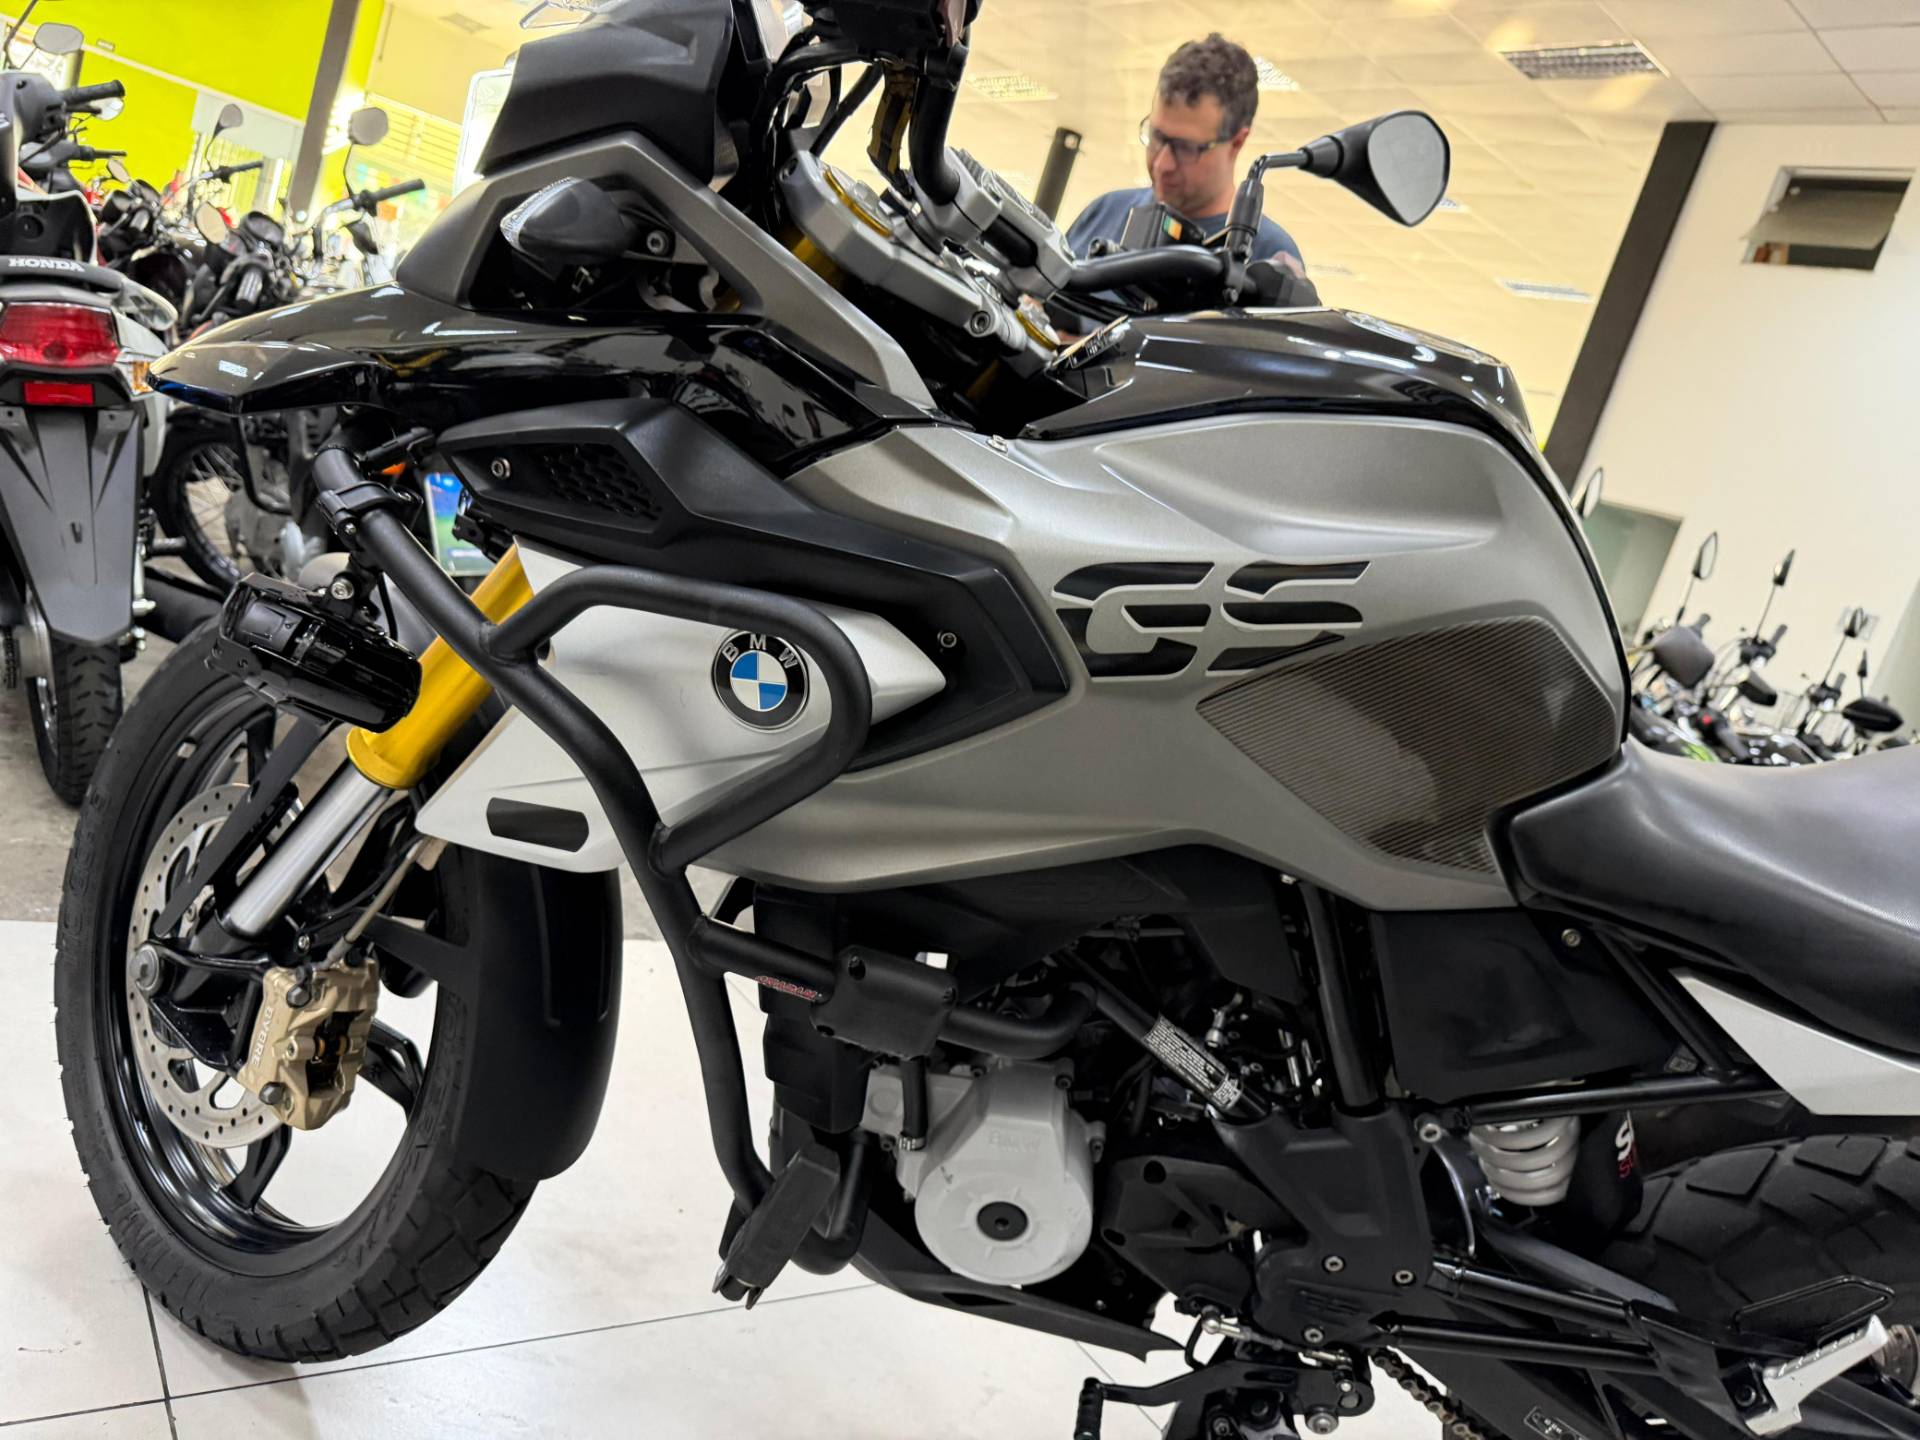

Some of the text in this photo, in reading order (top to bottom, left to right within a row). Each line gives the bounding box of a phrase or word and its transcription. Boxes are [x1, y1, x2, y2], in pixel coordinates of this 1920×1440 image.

[8, 258, 86, 273] HONDA
[721, 633, 799, 669] BMW
[251, 1006, 274, 1068] BYBRE
